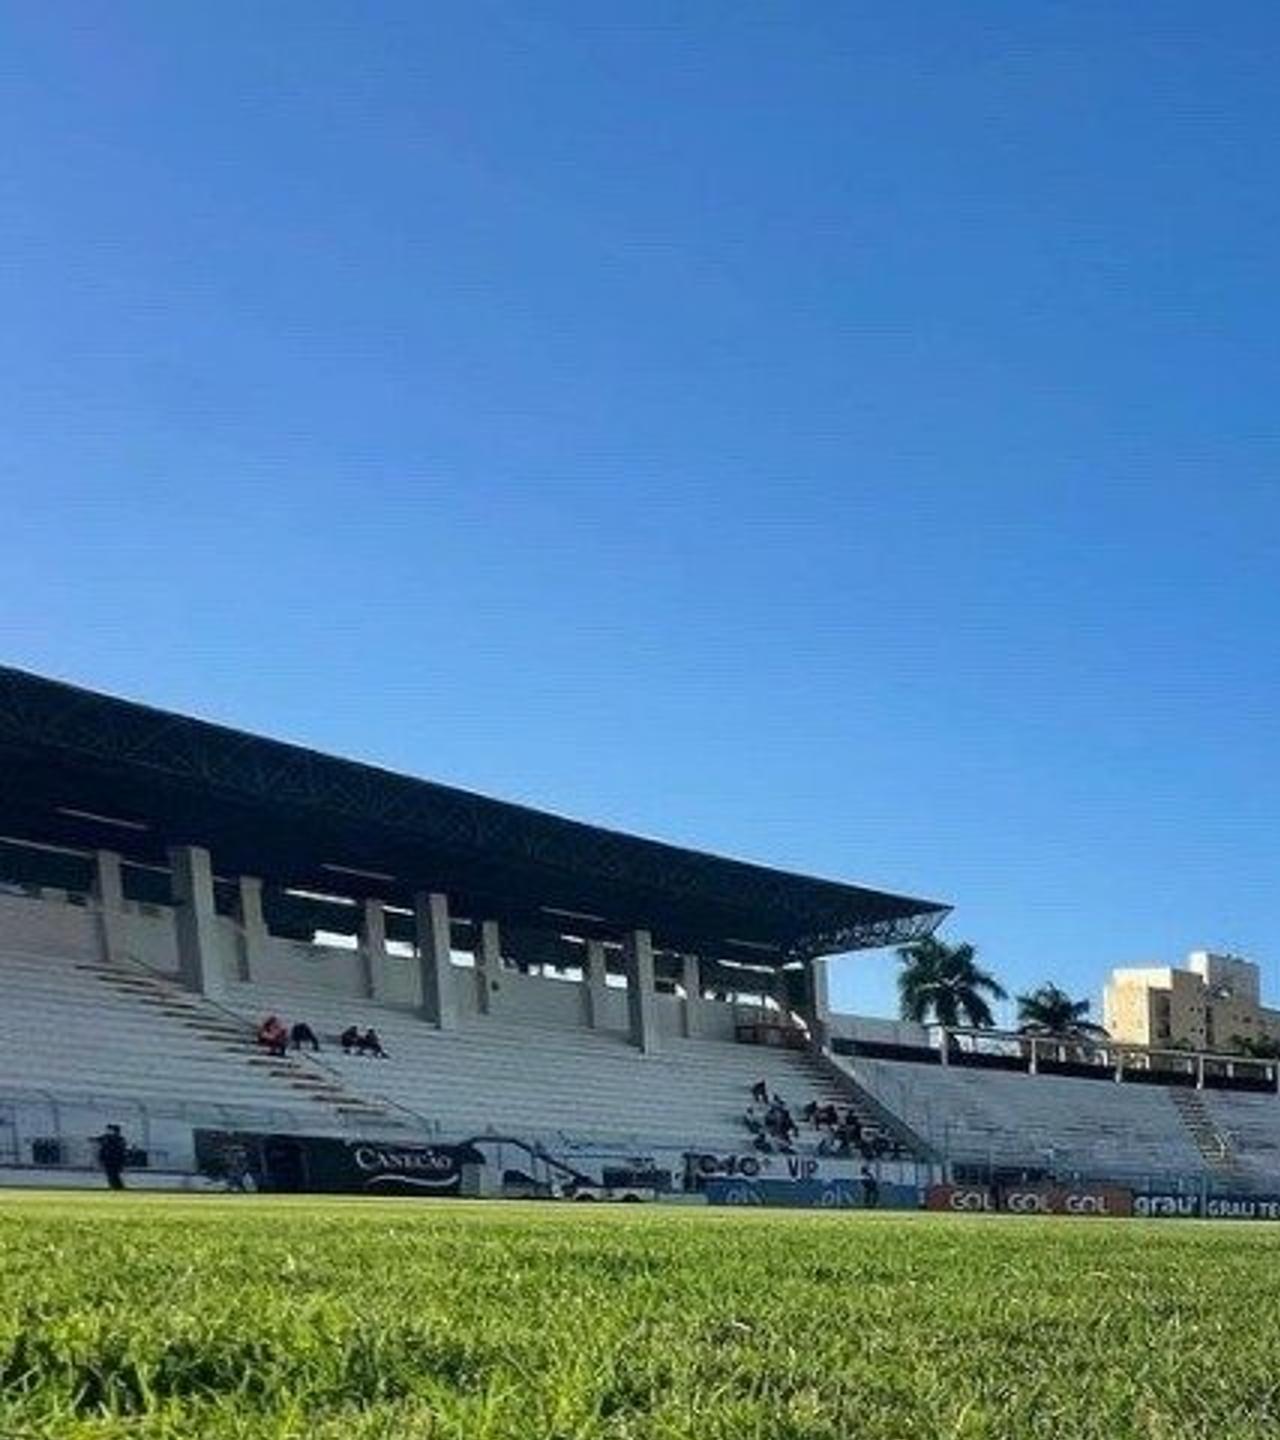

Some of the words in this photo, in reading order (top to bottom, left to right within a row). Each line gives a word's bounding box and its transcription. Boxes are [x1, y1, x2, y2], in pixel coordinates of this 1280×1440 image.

[787, 1157, 819, 1179] VIP
[951, 1191, 993, 1210] GOL
[1008, 1193, 1053, 1212] GOL
[1066, 1196, 1110, 1213] GOL
